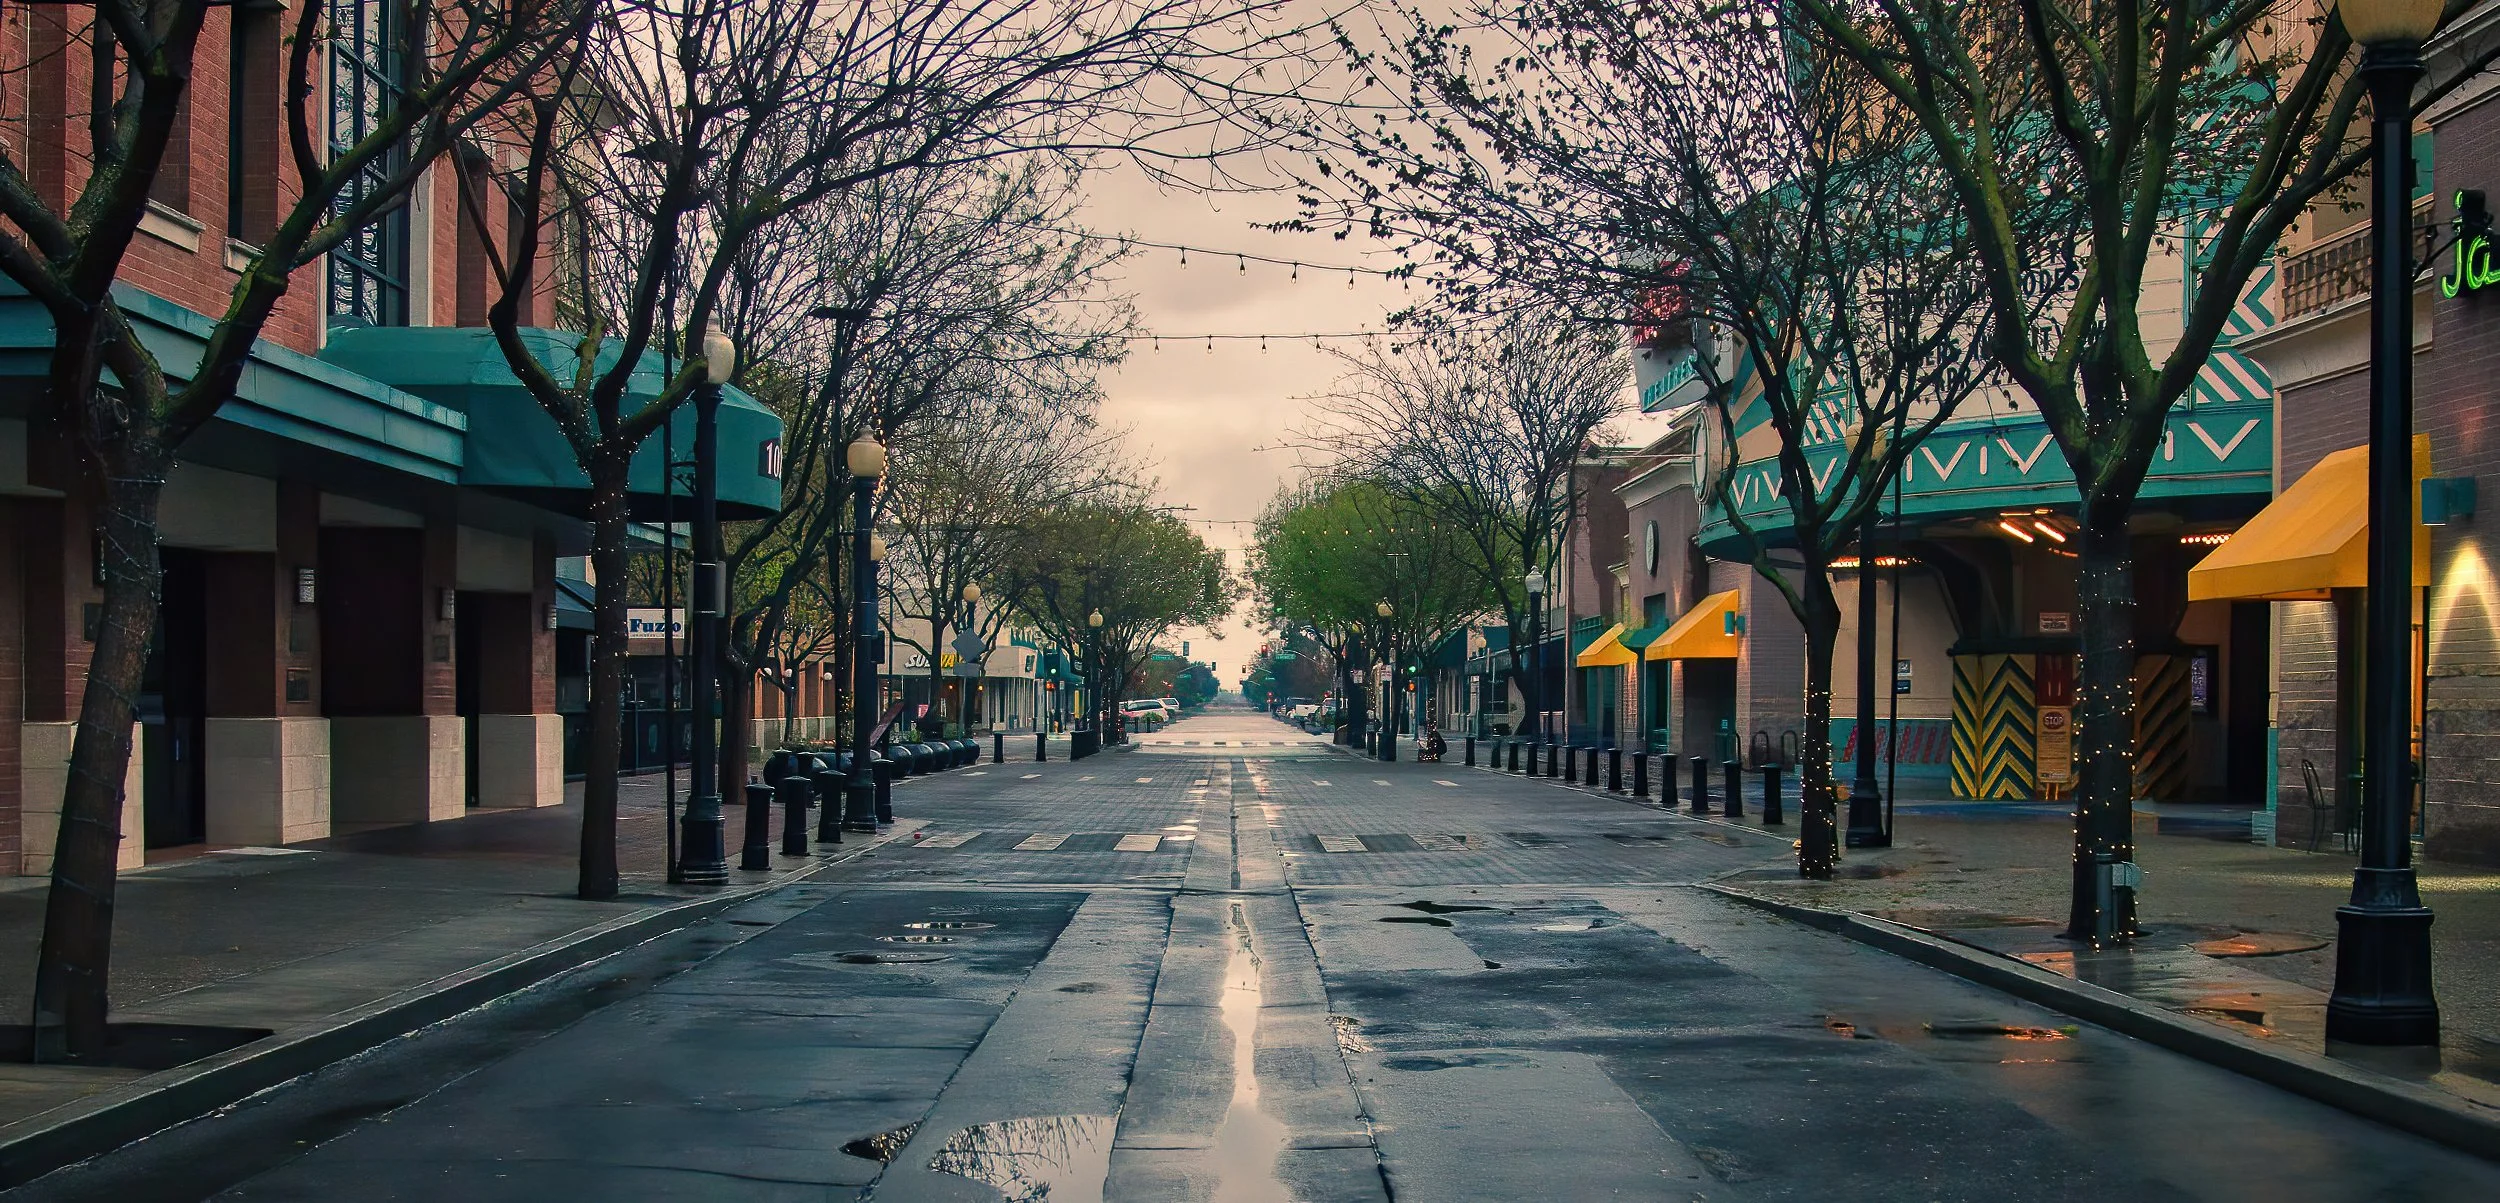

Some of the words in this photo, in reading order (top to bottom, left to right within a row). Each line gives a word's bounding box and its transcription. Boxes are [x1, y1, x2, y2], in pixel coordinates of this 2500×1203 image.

[1643, 354, 1697, 409] THEATRES
[629, 618, 682, 633] Fuzo
[2044, 716, 2064, 726] STOP
